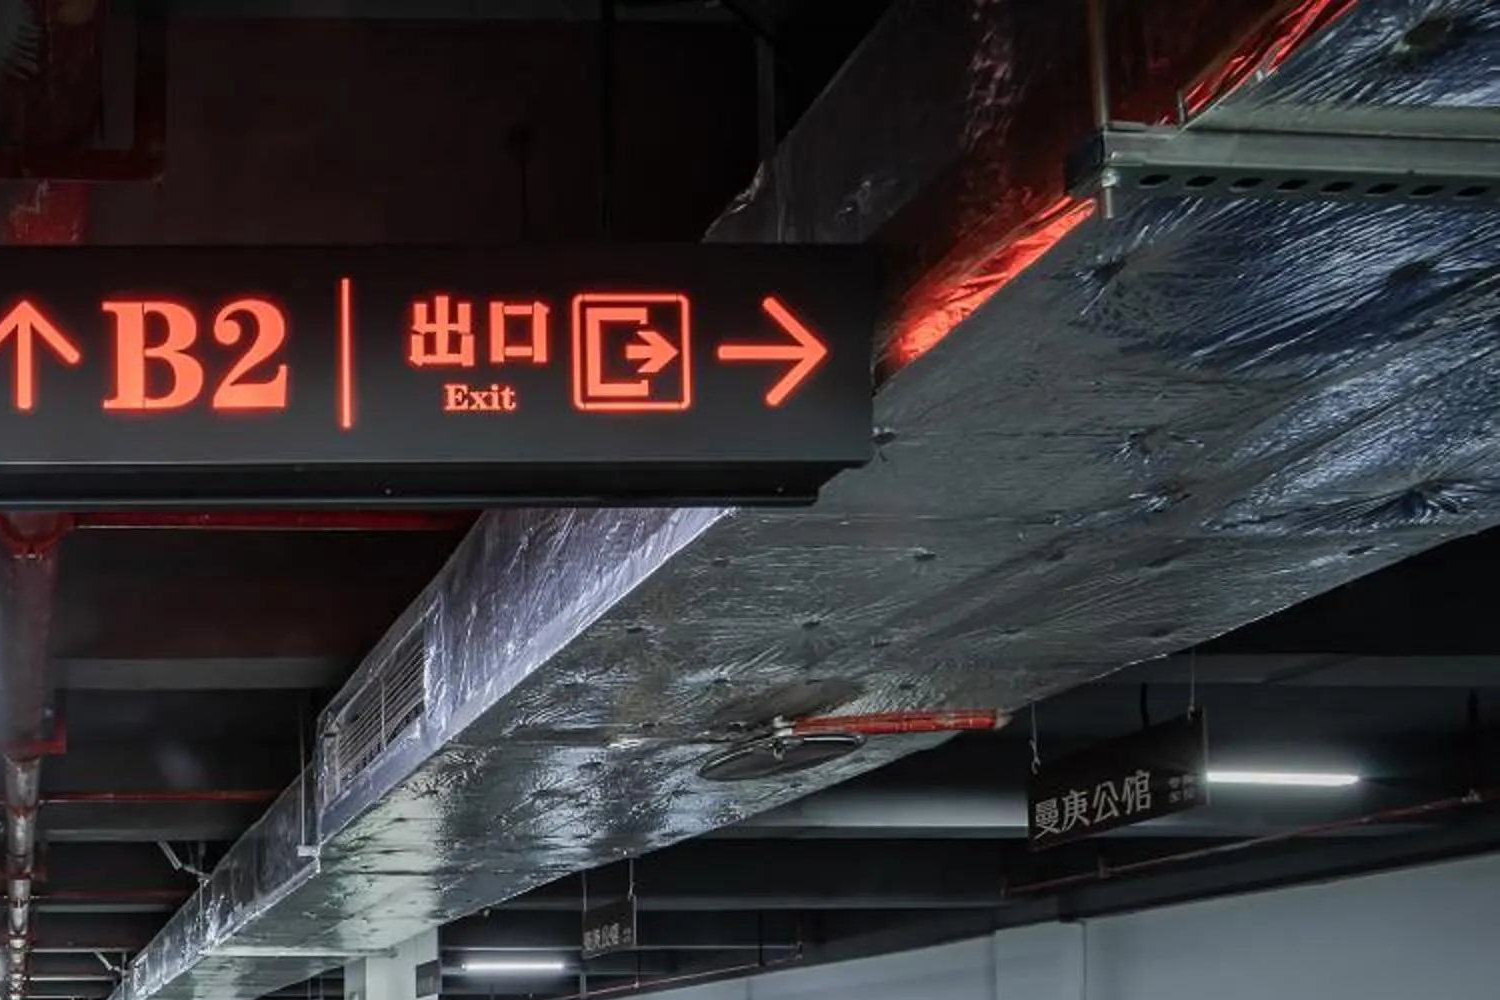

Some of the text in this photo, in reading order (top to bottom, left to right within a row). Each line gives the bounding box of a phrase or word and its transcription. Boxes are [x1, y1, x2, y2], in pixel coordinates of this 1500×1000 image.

[102, 298, 288, 411] B2
[408, 295, 549, 367] 出口
[444, 383, 517, 411] Exit
[1034, 769, 1151, 839] 曼庚公馆
